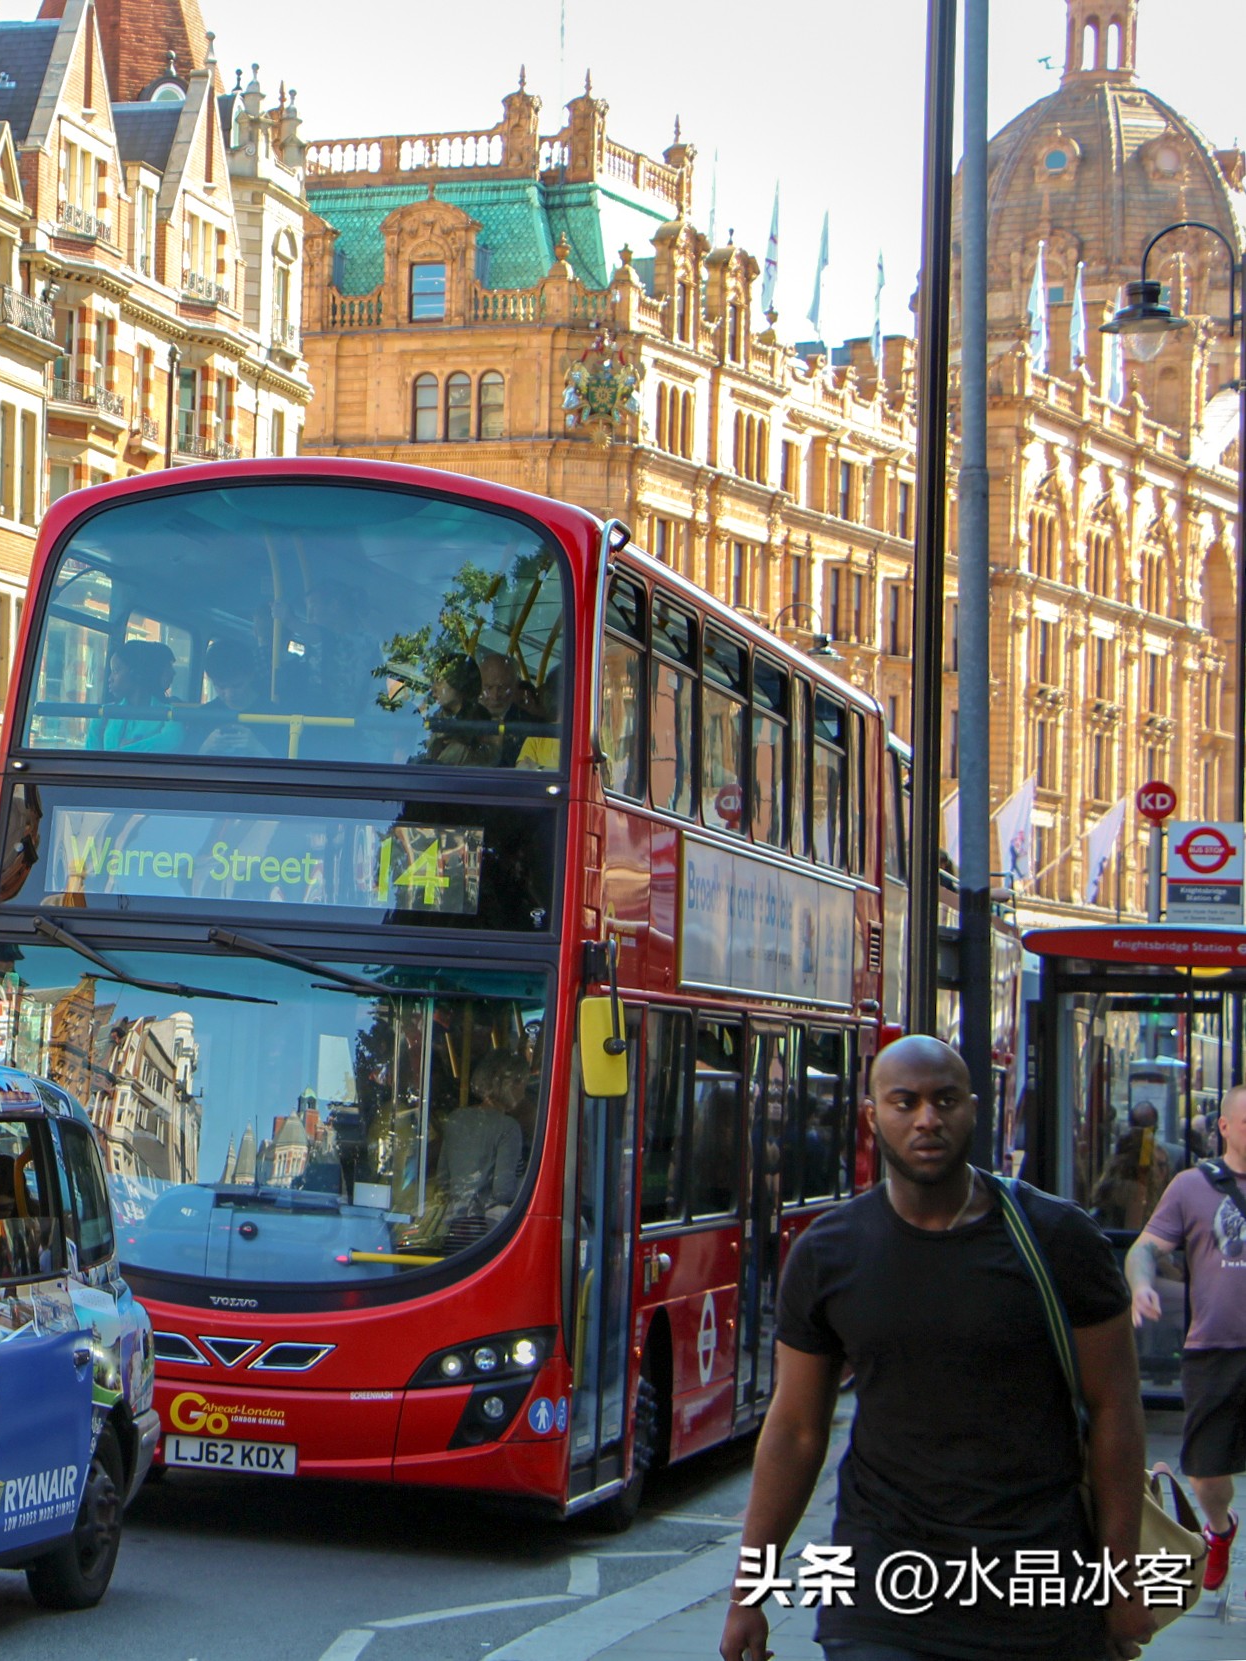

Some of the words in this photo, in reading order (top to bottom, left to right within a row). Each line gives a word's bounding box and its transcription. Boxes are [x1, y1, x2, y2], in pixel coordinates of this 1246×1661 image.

[1140, 793, 1171, 810] KD
[1188, 846, 1203, 854] BUS
[1204, 846, 1225, 855] STOP
[70, 835, 194, 879] Warren
[210, 841, 321, 885] Street
[377, 837, 450, 905] 14
[1180, 886, 1227, 895] Knightsbridge
[1186, 893, 1211, 901] Station
[1113, 940, 1189, 953] Knightsbridge
[1192, 941, 1232, 953] Station
[209, 1296, 259, 1307] VOLVO
[350, 1391, 394, 1400] SCREENWASH
[169, 1392, 229, 1435] Go
[231, 1415, 257, 1424] LONDON
[258, 1416, 286, 1427] GENERAL
[174, 1439, 234, 1466] LJ62
[240, 1445, 286, 1470] KOX
[4, 1465, 78, 1514] RYANAIR
[3, 1515, 17, 1533] LOW
[18, 1509, 38, 1528] FARES
[39, 1505, 55, 1522] MADE
[55, 1500, 75, 1518] SIMPLE
